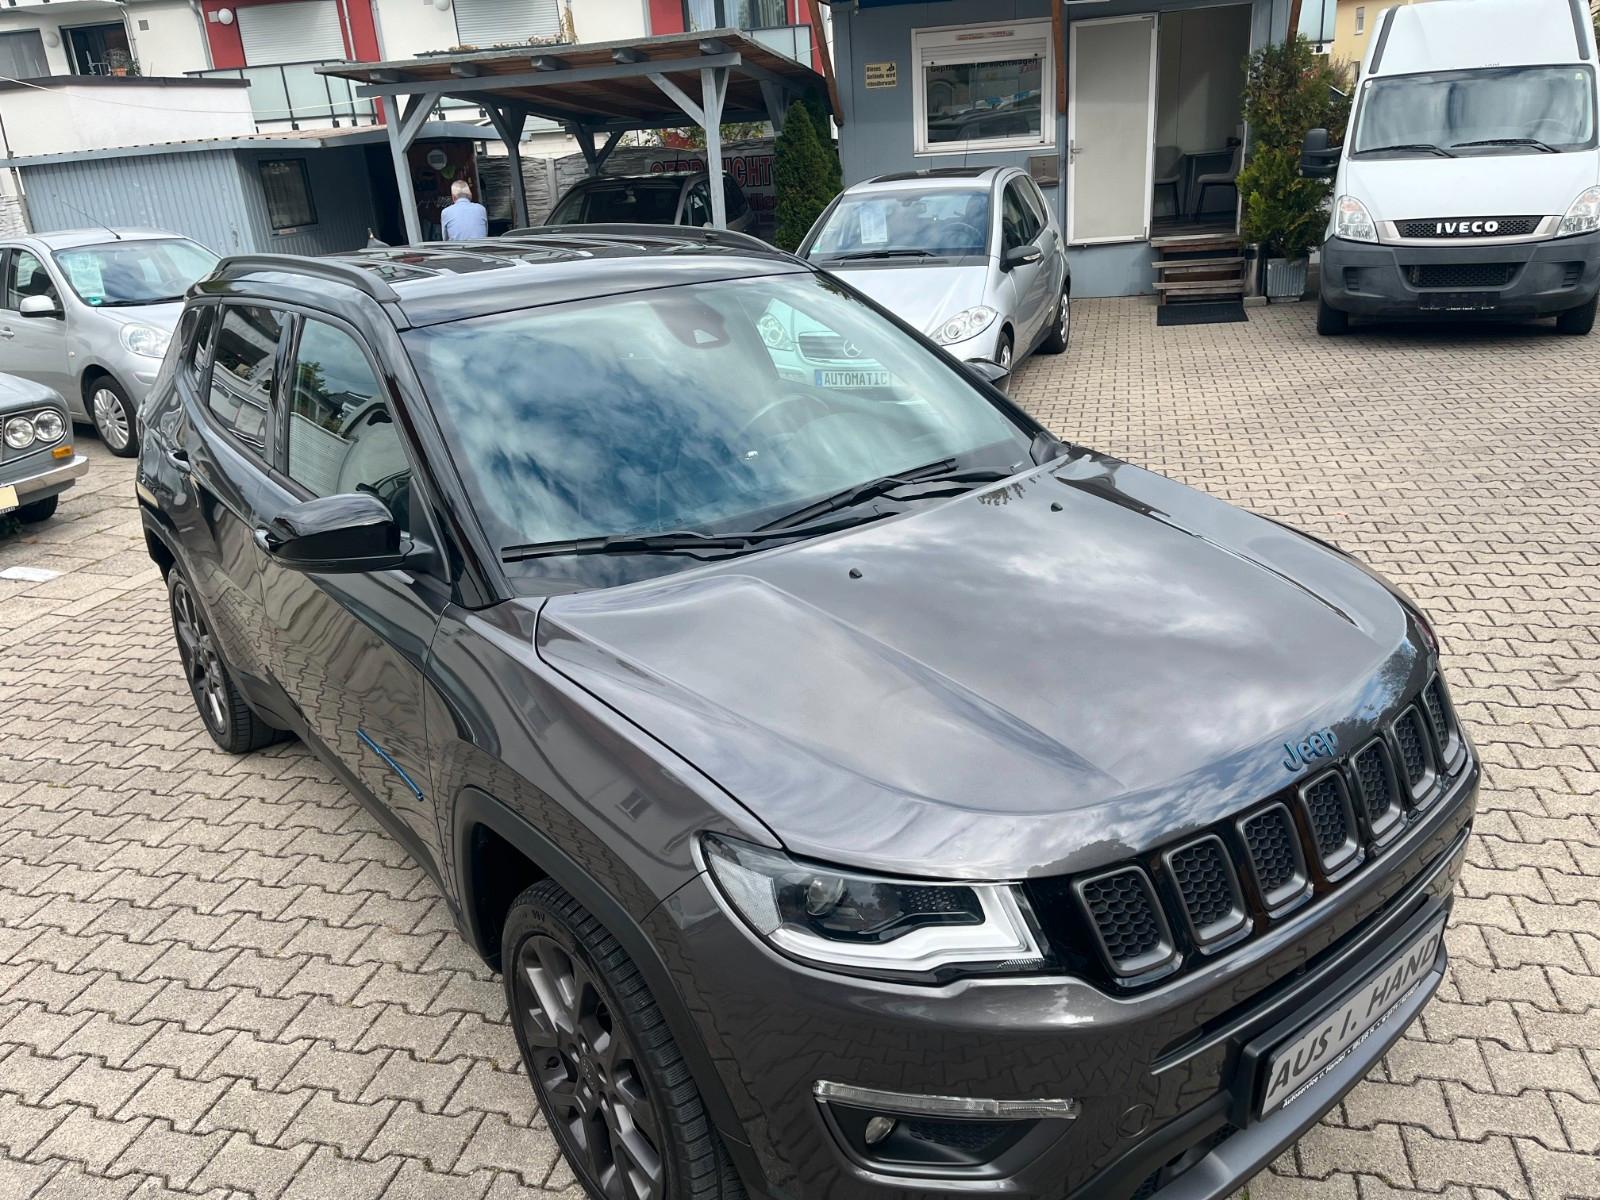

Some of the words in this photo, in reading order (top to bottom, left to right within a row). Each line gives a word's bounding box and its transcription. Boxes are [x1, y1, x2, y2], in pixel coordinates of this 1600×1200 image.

[1436, 221, 1499, 234] IVECO
[824, 372, 888, 386] AUTOMATIC
[1283, 727, 1339, 772] Jeep
[1268, 1026, 1333, 1098] AUS
[1366, 933, 1439, 1018] HAND
